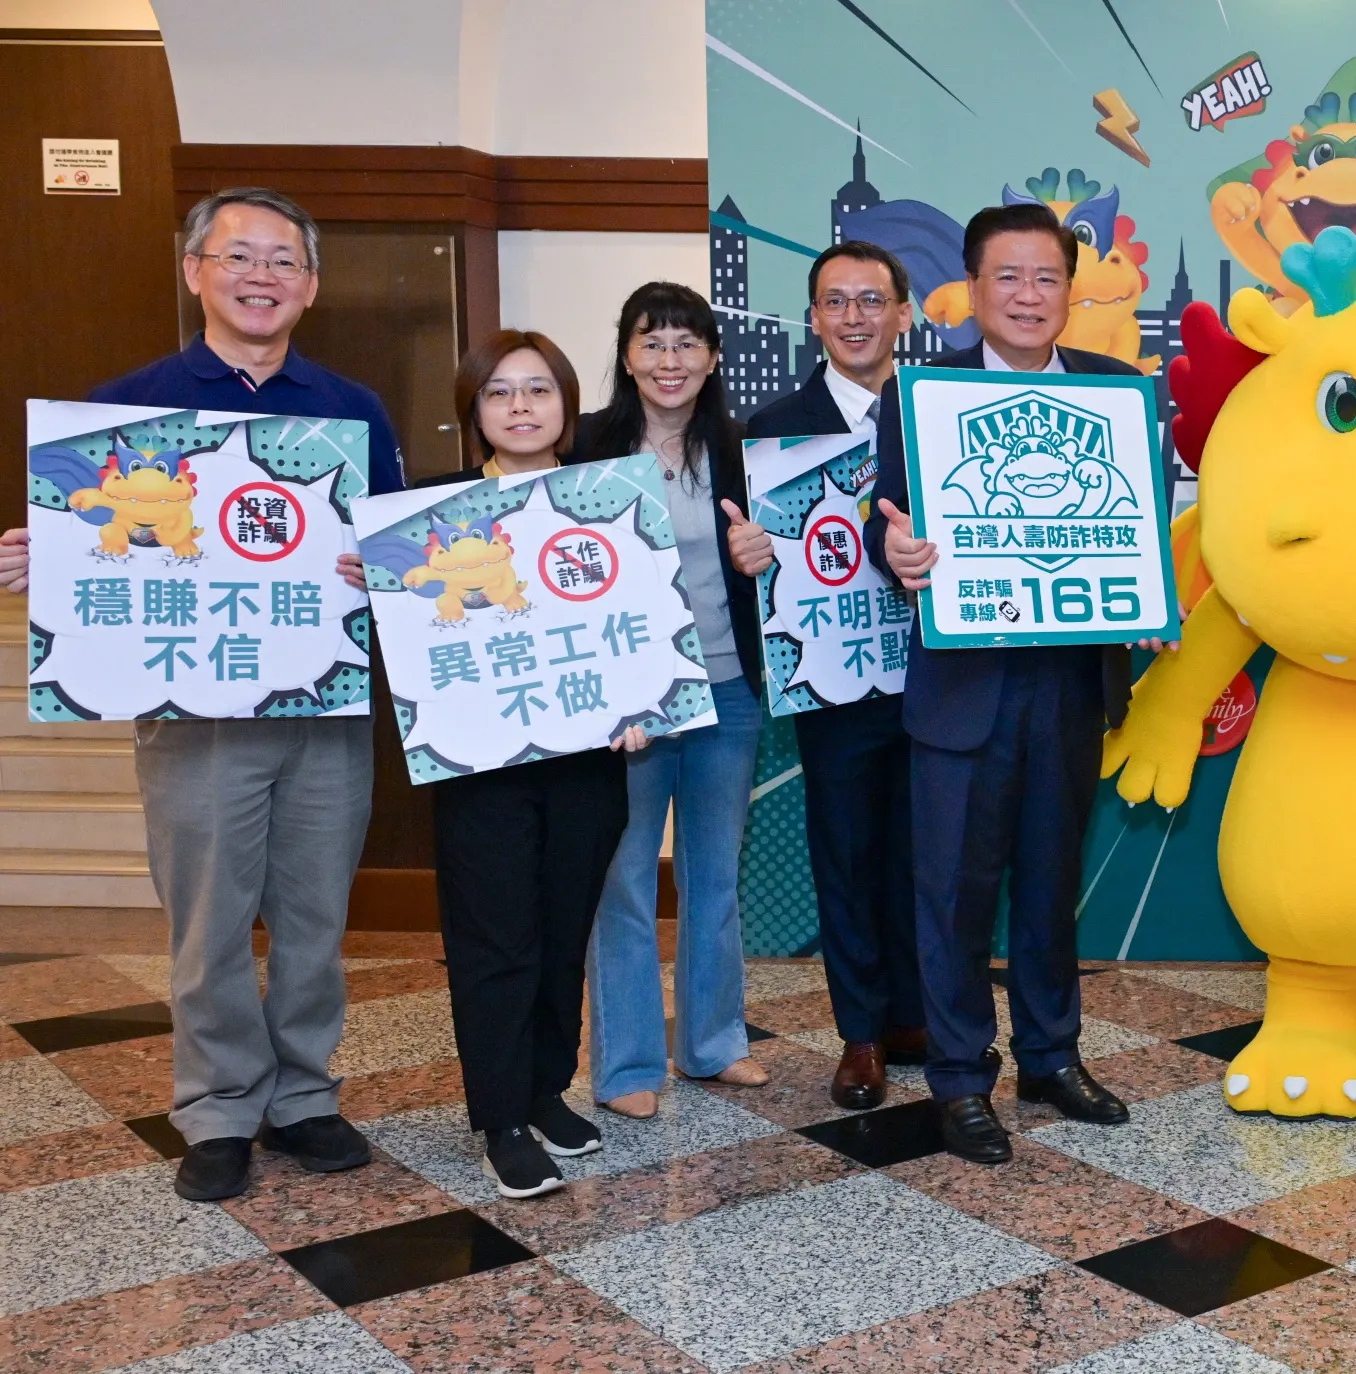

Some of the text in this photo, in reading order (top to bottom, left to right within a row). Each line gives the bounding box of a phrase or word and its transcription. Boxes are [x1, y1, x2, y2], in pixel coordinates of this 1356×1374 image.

[1181, 60, 1272, 132] YEAH!
[850, 459, 878, 488] YEAH!
[237, 496, 288, 520] 投資
[237, 520, 288, 544] 詐騙
[817, 530, 848, 551] 優惠
[952, 523, 1138, 549] 台灣人壽防詐特攻
[554, 540, 600, 566] 工作
[820, 551, 849, 573] 詐騙
[556, 563, 605, 589] 詐騙
[957, 578, 1013, 599] 反詐騙
[73, 577, 322, 627] 穩賺不賠
[797, 587, 911, 638] 不明連
[959, 602, 998, 623] 專線
[1021, 576, 1141, 624] 165
[143, 633, 262, 682] 不信
[428, 611, 651, 691] 異常工作
[496, 669, 609, 727] 不做
